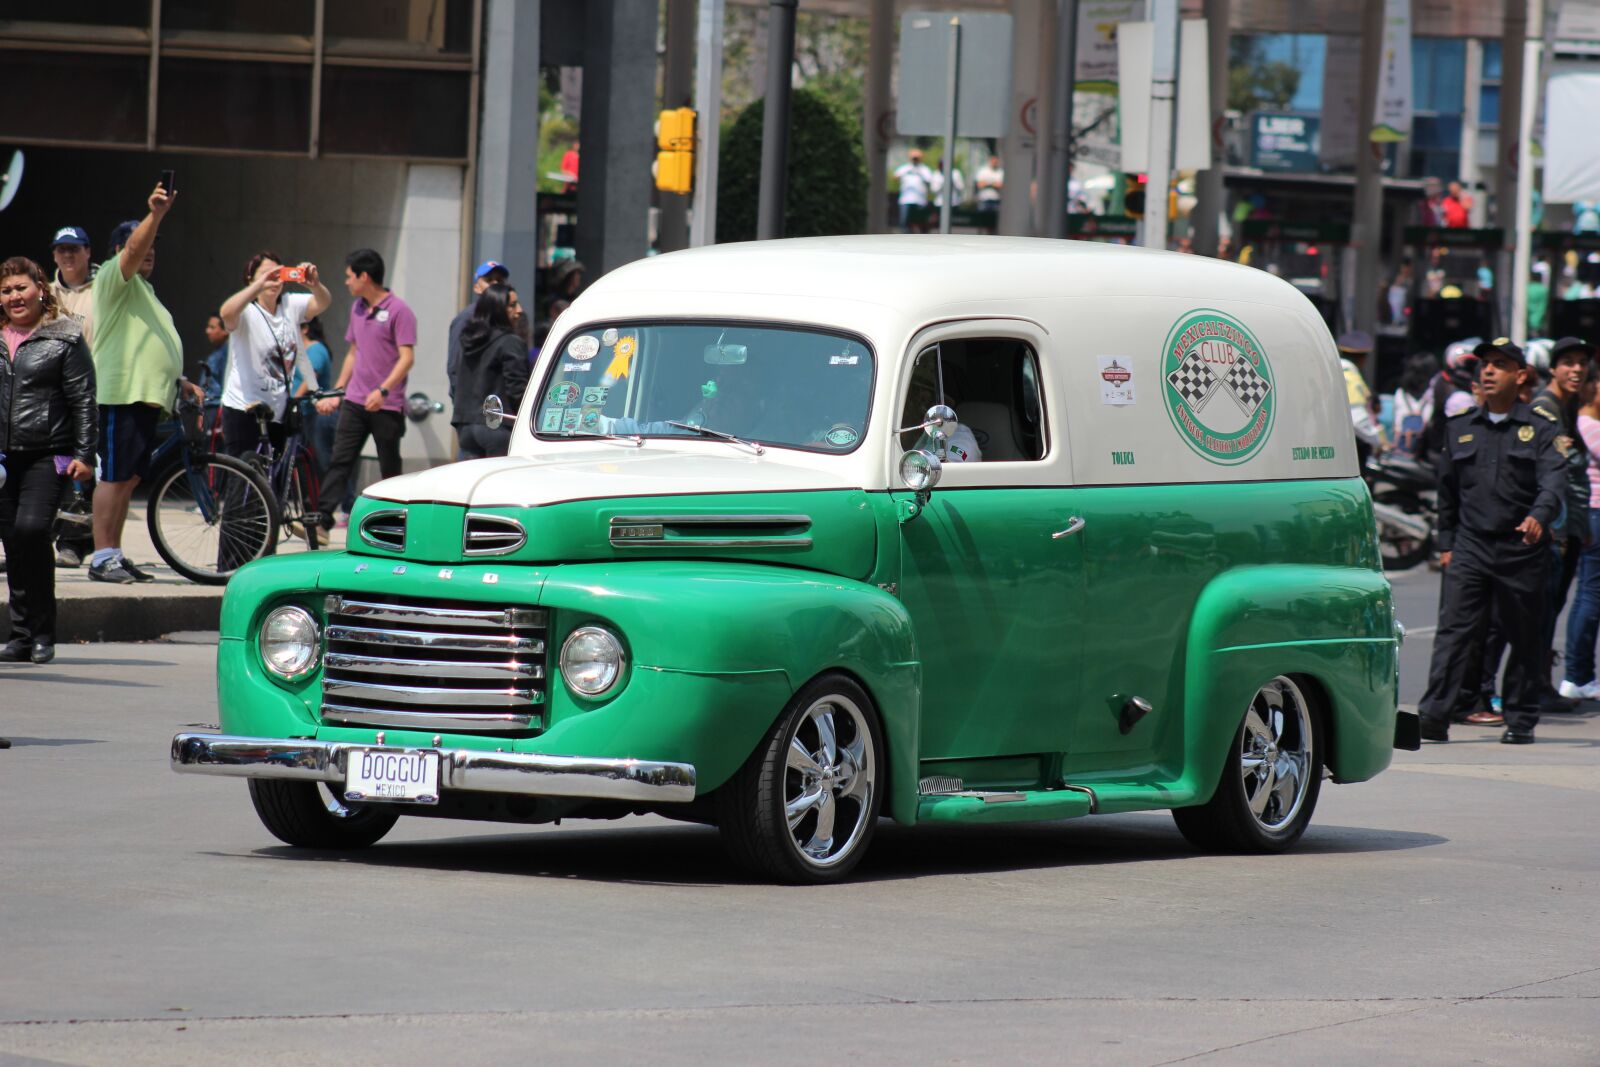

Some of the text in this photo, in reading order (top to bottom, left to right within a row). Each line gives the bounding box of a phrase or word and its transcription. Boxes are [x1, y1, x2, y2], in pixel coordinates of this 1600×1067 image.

[1173, 321, 1260, 367] MEXICALTZINGO
[1201, 341, 1236, 365] CLUB
[1111, 451, 1135, 465] TOLUCA
[620, 526, 655, 537] FORD
[354, 563, 499, 584] FORD
[375, 783, 406, 797] MEXICO
